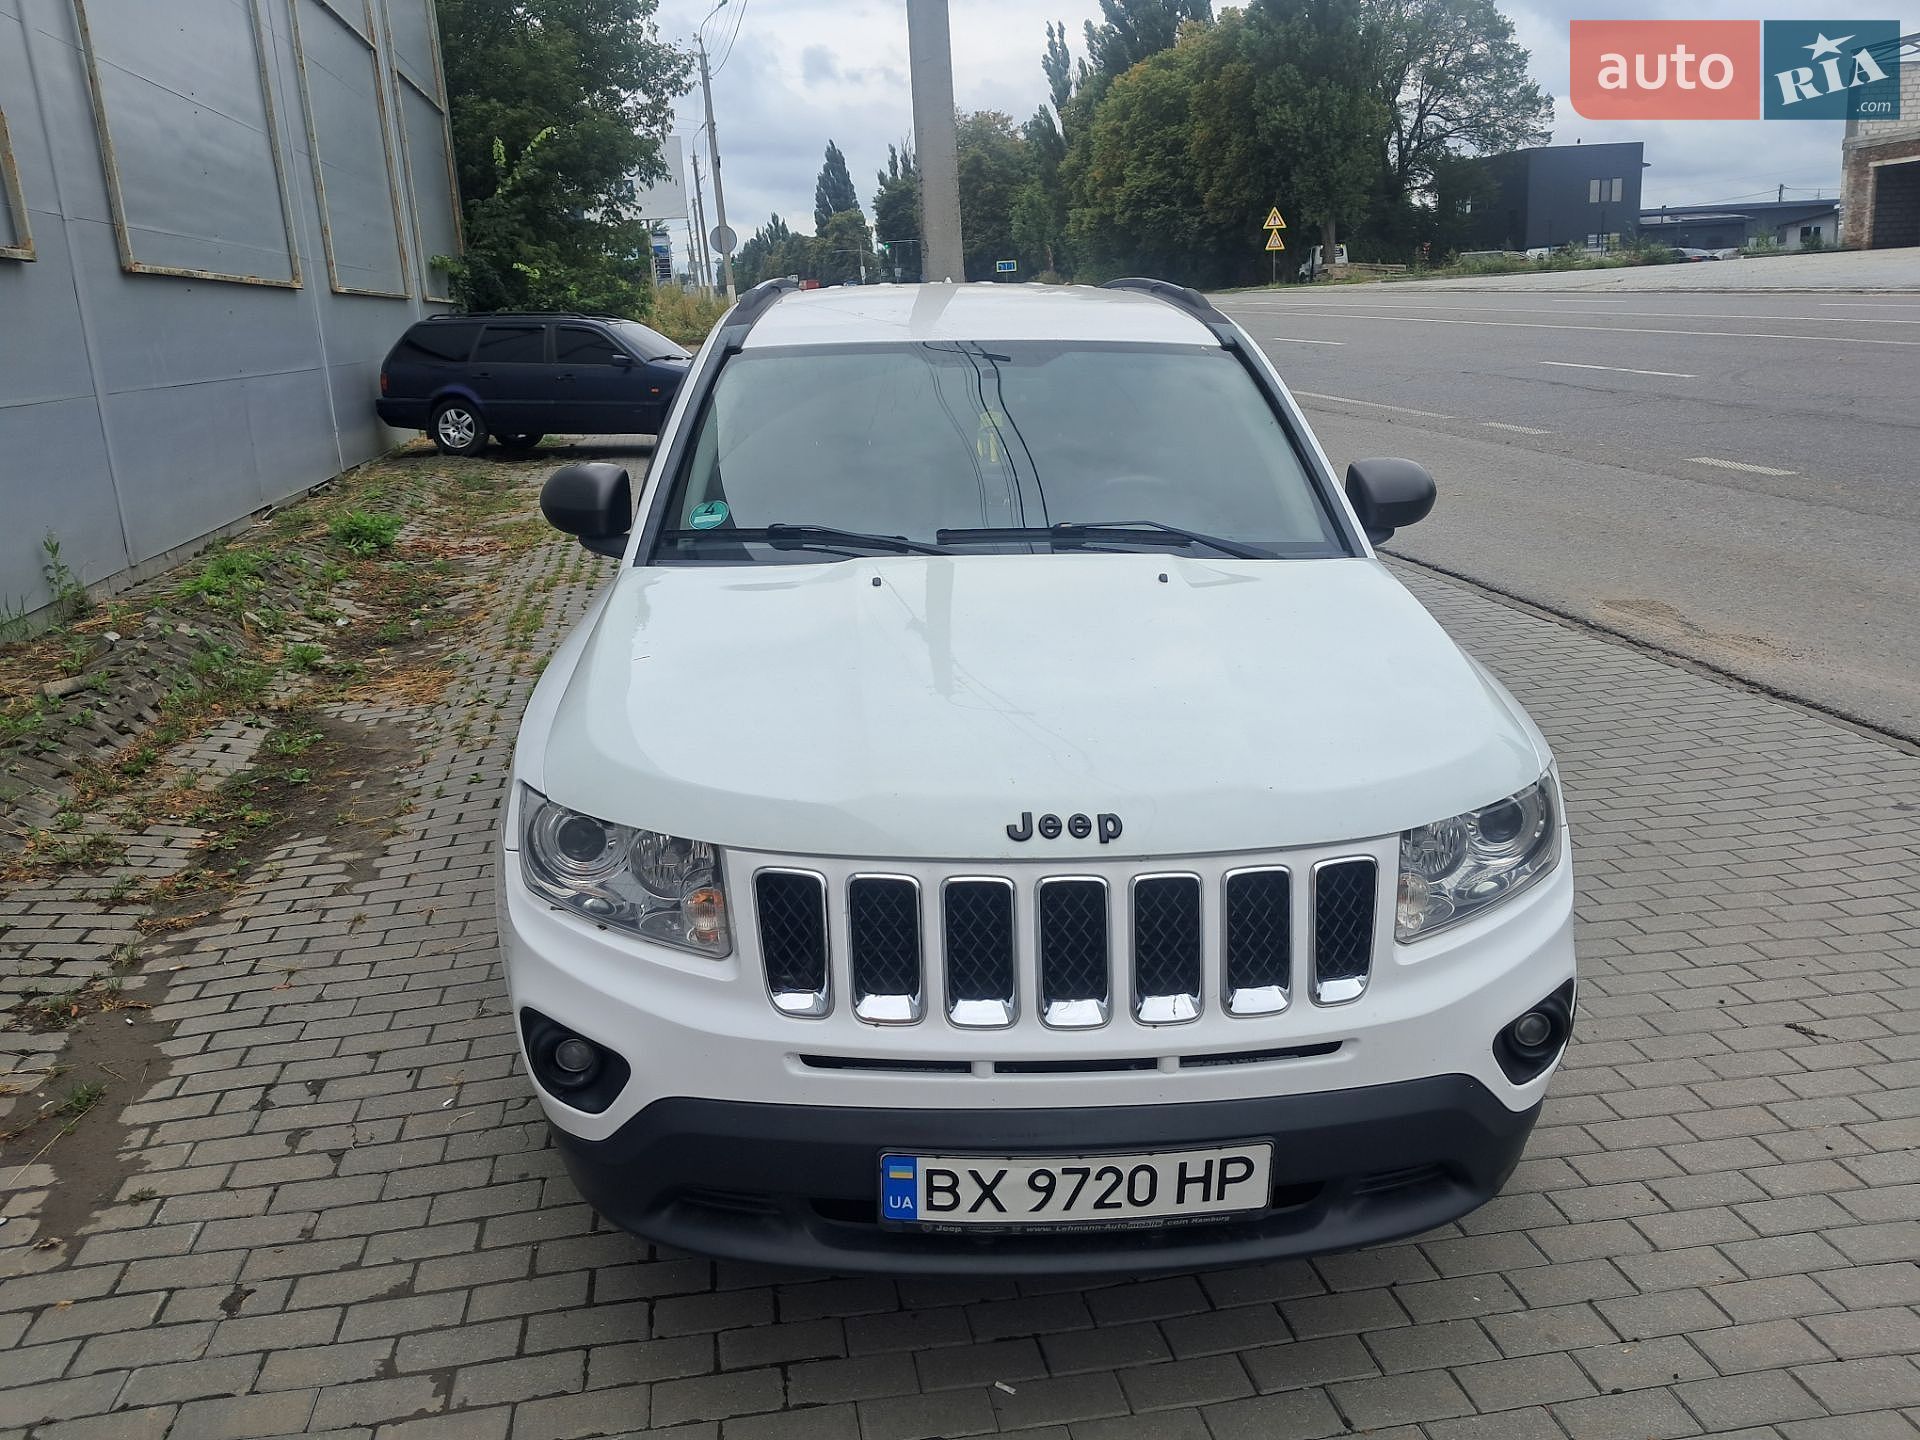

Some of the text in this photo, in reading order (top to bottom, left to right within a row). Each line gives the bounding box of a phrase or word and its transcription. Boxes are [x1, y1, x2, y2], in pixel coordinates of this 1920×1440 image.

[1006, 811, 1123, 844] Jeep
[925, 1156, 1255, 1212] BX 9720 HP
[889, 1195, 913, 1209] UA
